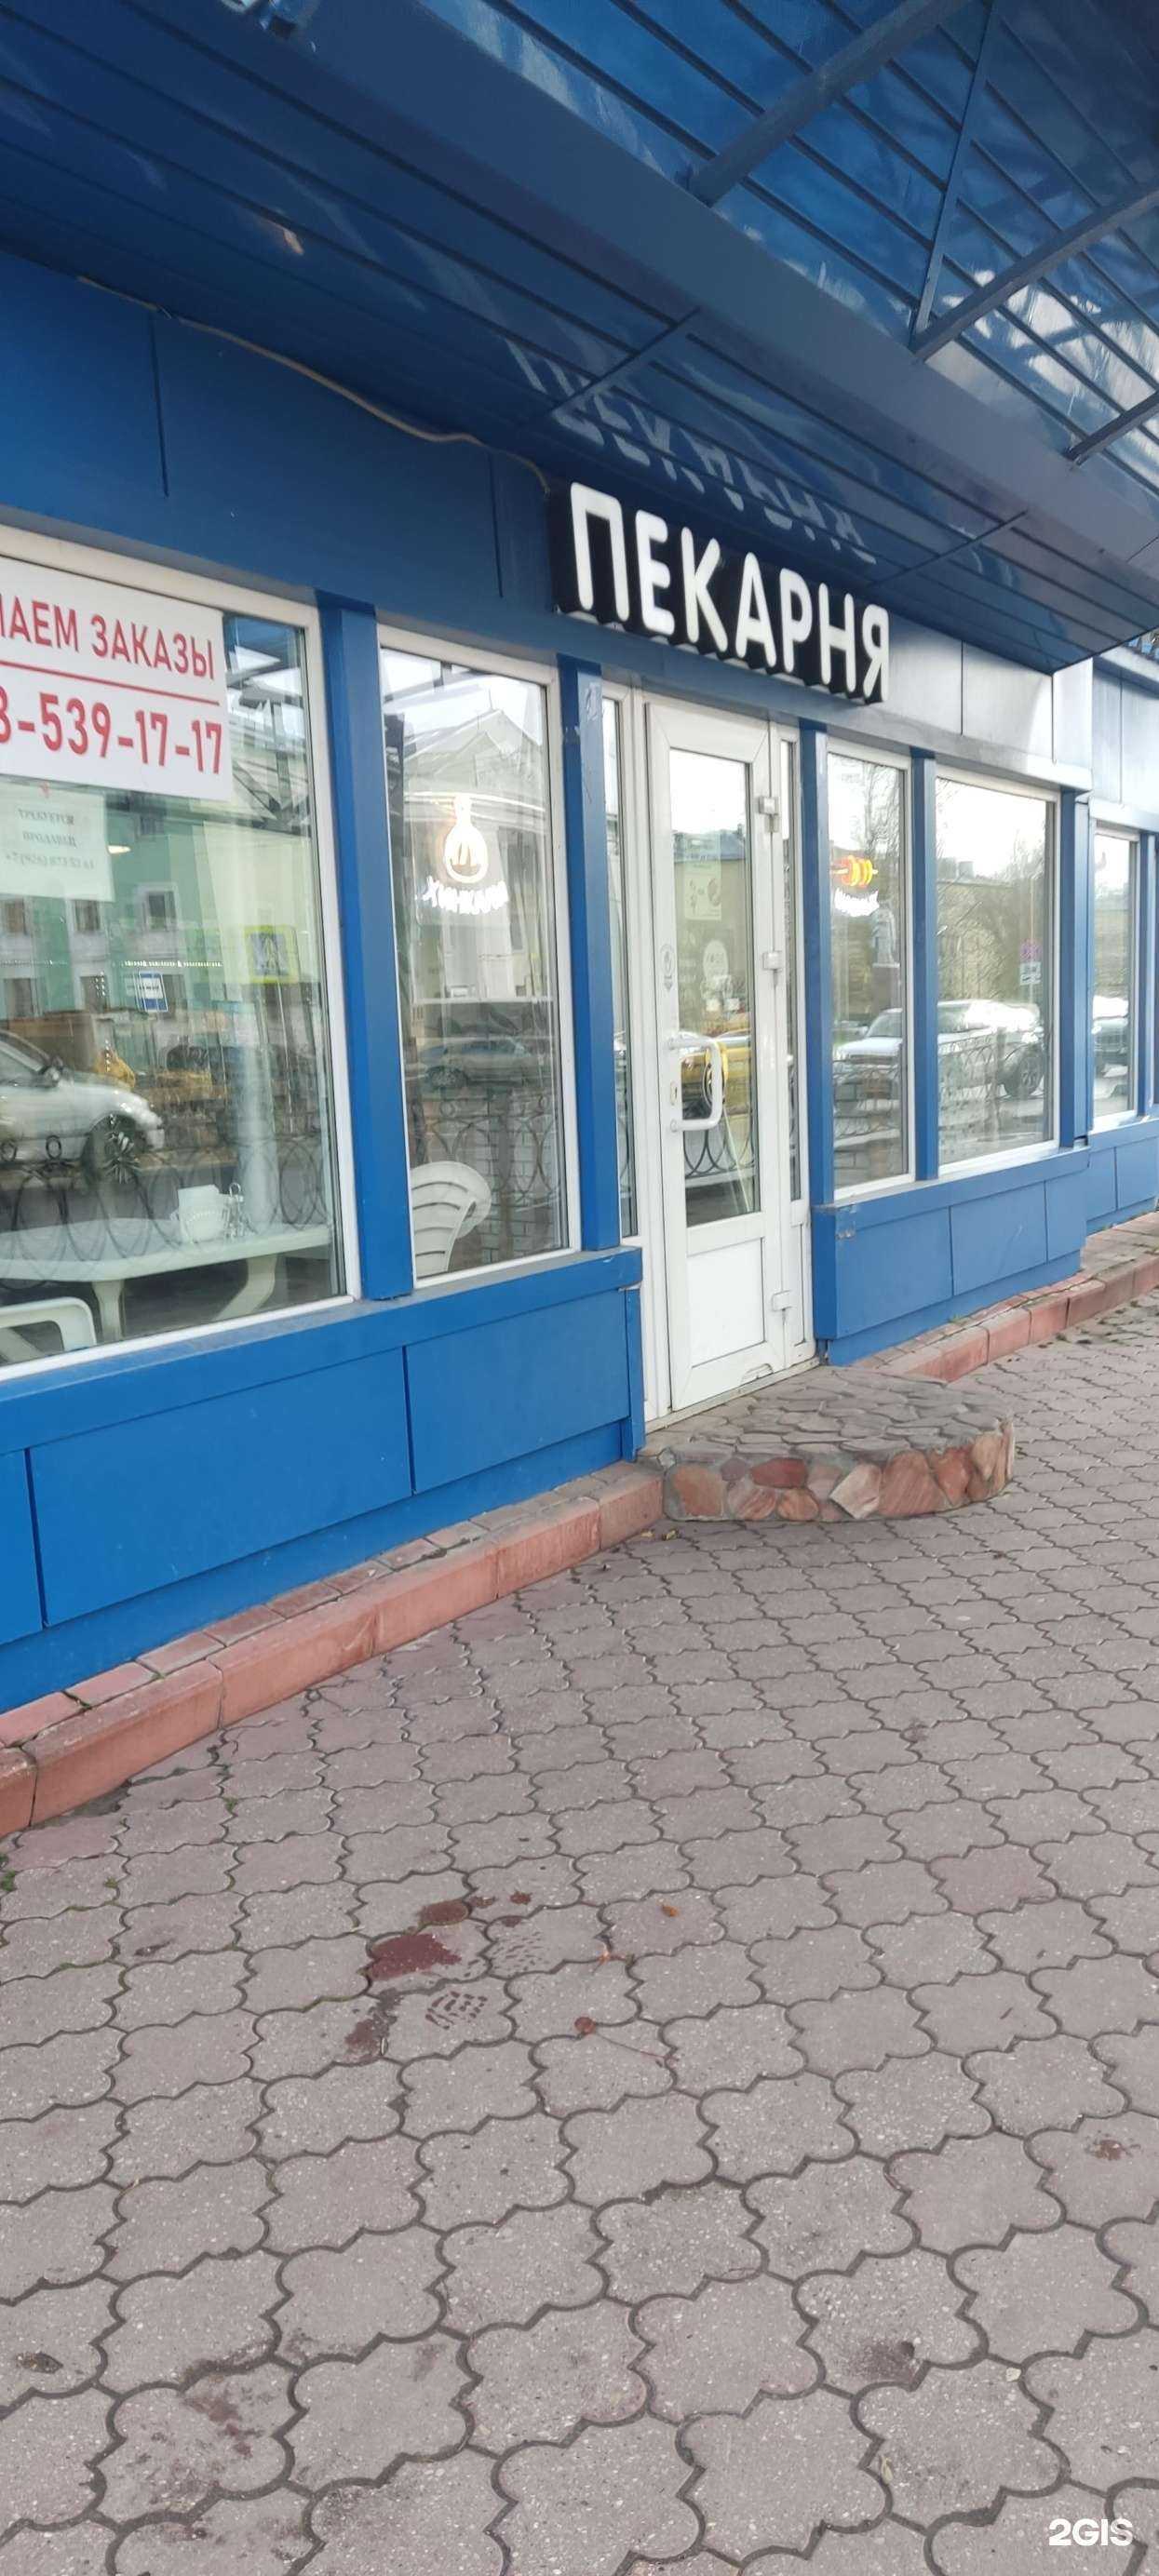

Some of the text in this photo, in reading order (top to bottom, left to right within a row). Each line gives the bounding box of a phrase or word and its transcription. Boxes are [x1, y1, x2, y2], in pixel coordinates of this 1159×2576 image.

[0, 593, 215, 680] АЕМ ЗАКАЗЫ
[570, 481, 890, 704] ПЕКАРНЯ
